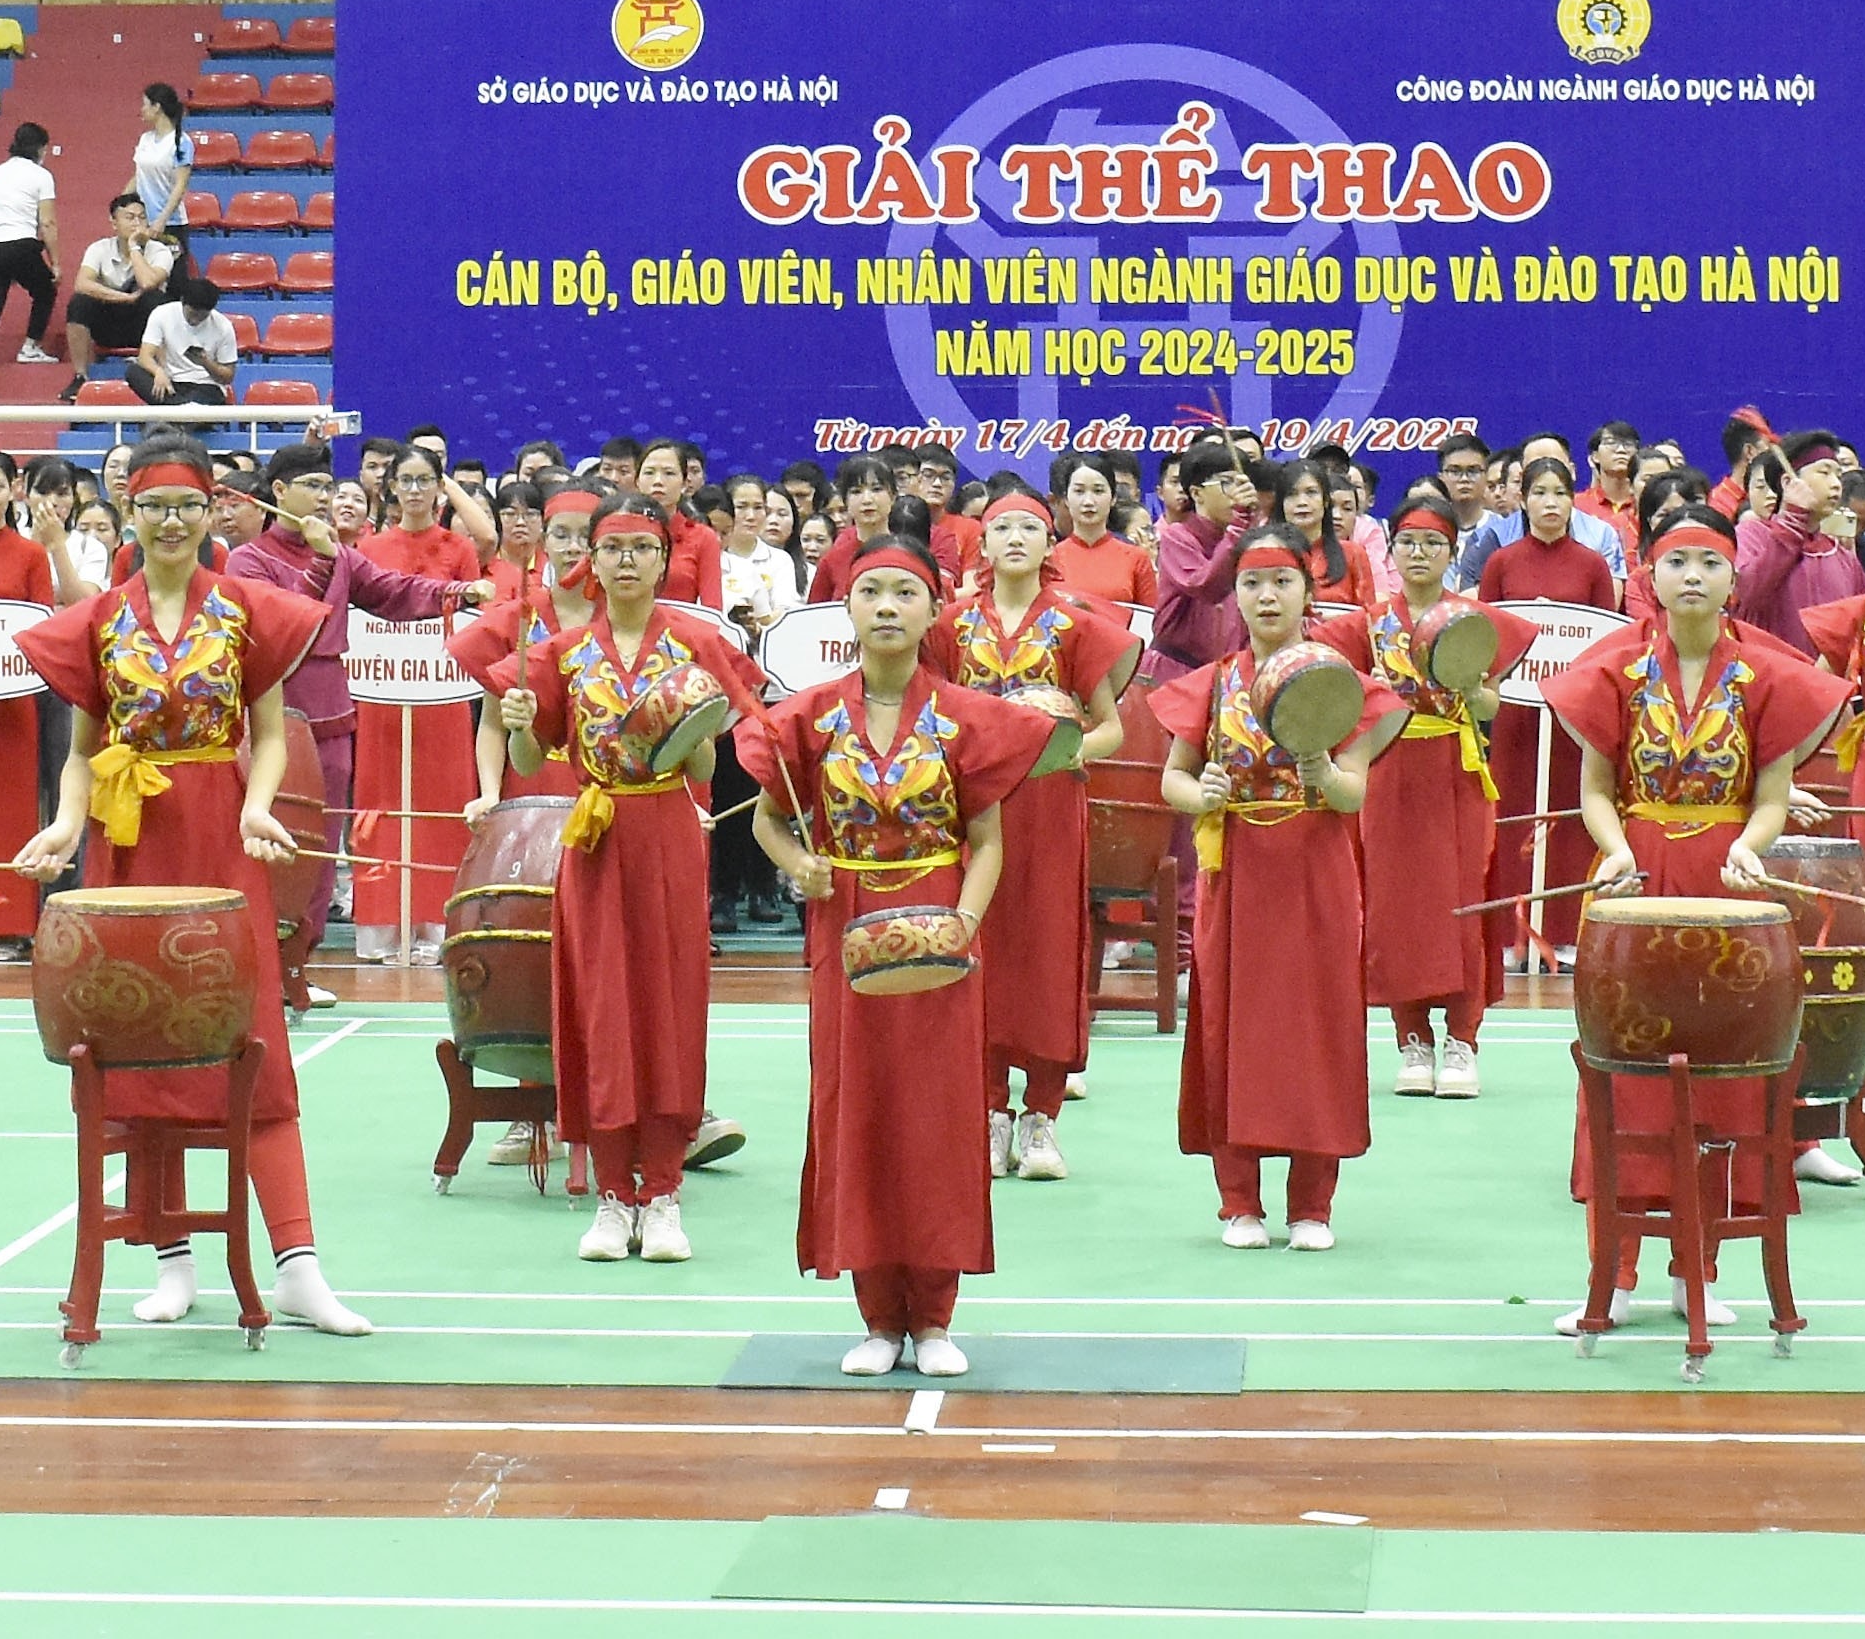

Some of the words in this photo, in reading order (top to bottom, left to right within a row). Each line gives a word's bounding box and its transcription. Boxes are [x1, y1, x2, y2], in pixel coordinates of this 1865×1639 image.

[477, 75, 507, 104] SỞ
[512, 76, 569, 104] GIÁO
[573, 81, 620, 109] DỤC
[624, 75, 656, 103] VÀ
[660, 74, 709, 102] ĐÀO
[713, 80, 758, 108] TẠO
[762, 74, 794, 102] HÀ
[799, 74, 838, 108] NỘI
[1396, 74, 1464, 102] CÔNG
[1468, 74, 1533, 102] ĐOÀN
[1538, 73, 1618, 101] NGÀNH
[1623, 73, 1681, 101] GIÁO
[1685, 78, 1733, 107] DỤC
[1738, 73, 1770, 101] HÀ
[1775, 73, 1815, 107] NỘI
[737, 114, 981, 226] GIẢI
[998, 100, 1223, 225] THỂ
[1240, 141, 1552, 224] THAO
[456, 250, 540, 307] CÁN
[552, 249, 618, 316] BỘ,
[631, 249, 726, 306] GIÁO
[738, 248, 844, 309] VIÊN,
[856, 248, 971, 305] NHÂN
[983, 248, 1077, 305] VIÊN
[1090, 247, 1233, 304] NGÀNH
[1245, 247, 1342, 304] GIÁO
[1354, 255, 1437, 313] DỤC
[1449, 246, 1503, 303] VÀ
[1513, 245, 1598, 303] ĐÀO
[1609, 254, 1688, 312] TẠO
[1700, 245, 1757, 303] HÀ
[1768, 246, 1840, 313] NỘI
[935, 320, 1031, 376] NĂM
[1044, 328, 1127, 387] HỌC
[1139, 328, 1355, 376] 2024-2025
[815, 417, 869, 452] Từ
[976, 419, 1069, 459] 17/4
[1074, 414, 1145, 452] đến
[1559, 624, 1593, 639] GDĐT
[401, 659, 429, 682] GIA
